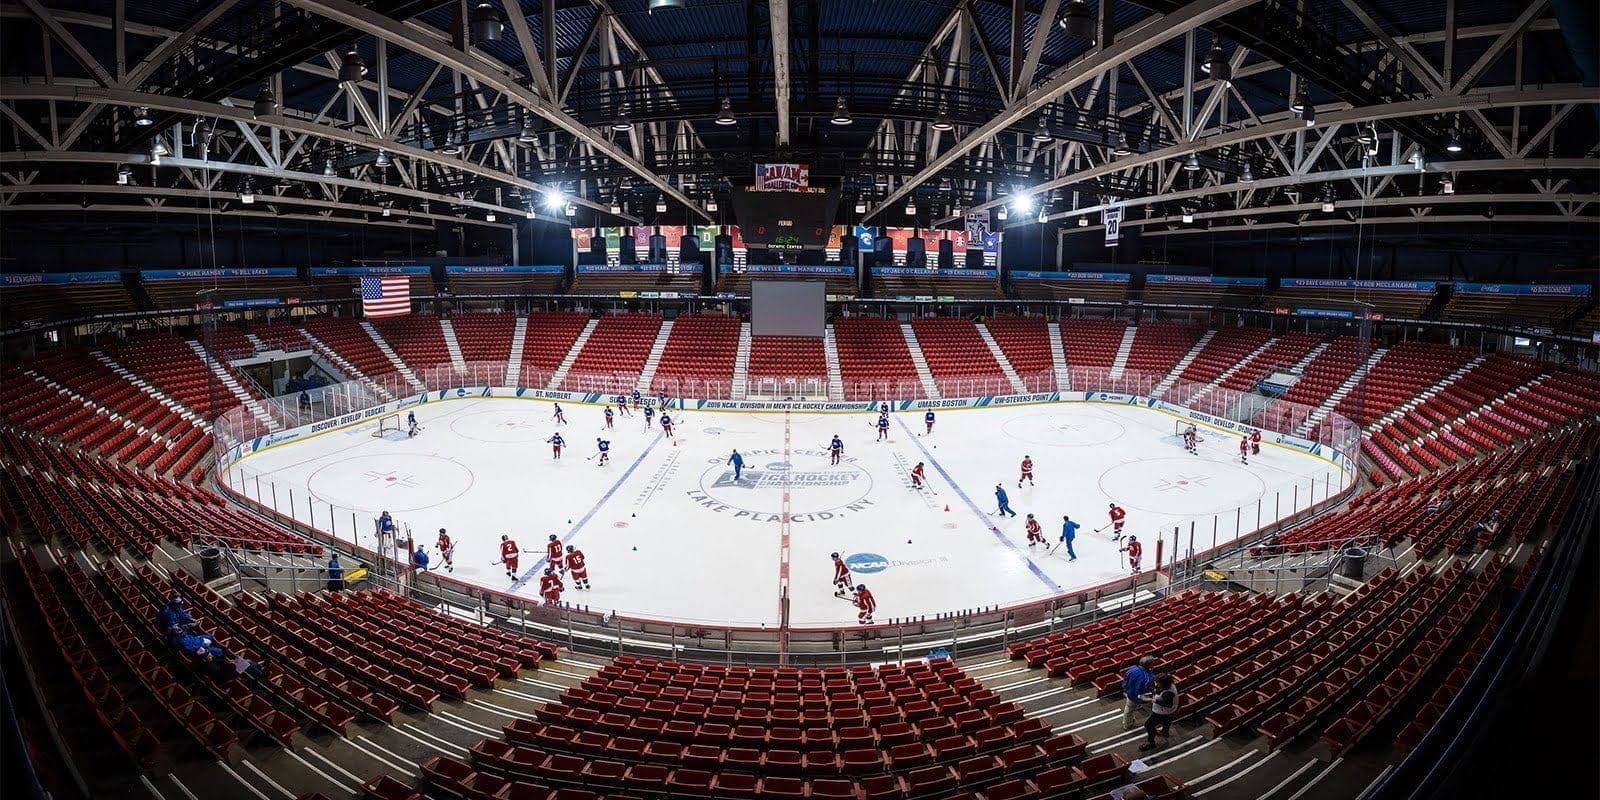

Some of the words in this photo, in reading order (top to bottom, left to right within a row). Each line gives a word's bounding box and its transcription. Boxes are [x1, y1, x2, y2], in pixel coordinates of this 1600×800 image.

[759, 226, 764, 235] 0
[1107, 219, 1117, 235] 20
[776, 236, 800, 244] 16:24
[545, 391, 572, 399] NORBERT
[994, 395, 1031, 404] UW-STEVENS
[1032, 393, 1050, 401] POINT
[825, 402, 868, 410] CHAMPIONSHIP
[917, 401, 941, 409] UMASS
[942, 399, 967, 407] BOSTON
[311, 418, 339, 433] DISCOVER
[341, 411, 363, 427] DEVELOP
[365, 405, 386, 418] DEDICATE
[1189, 411, 1211, 423] DISCOVER
[1214, 418, 1235, 430] DEVELOP
[687, 490, 730, 513] LAKE
[847, 499, 874, 512] NY
[507, 544, 512, 552] 2
[573, 556, 582, 564] 15
[850, 561, 888, 569] NCAA
